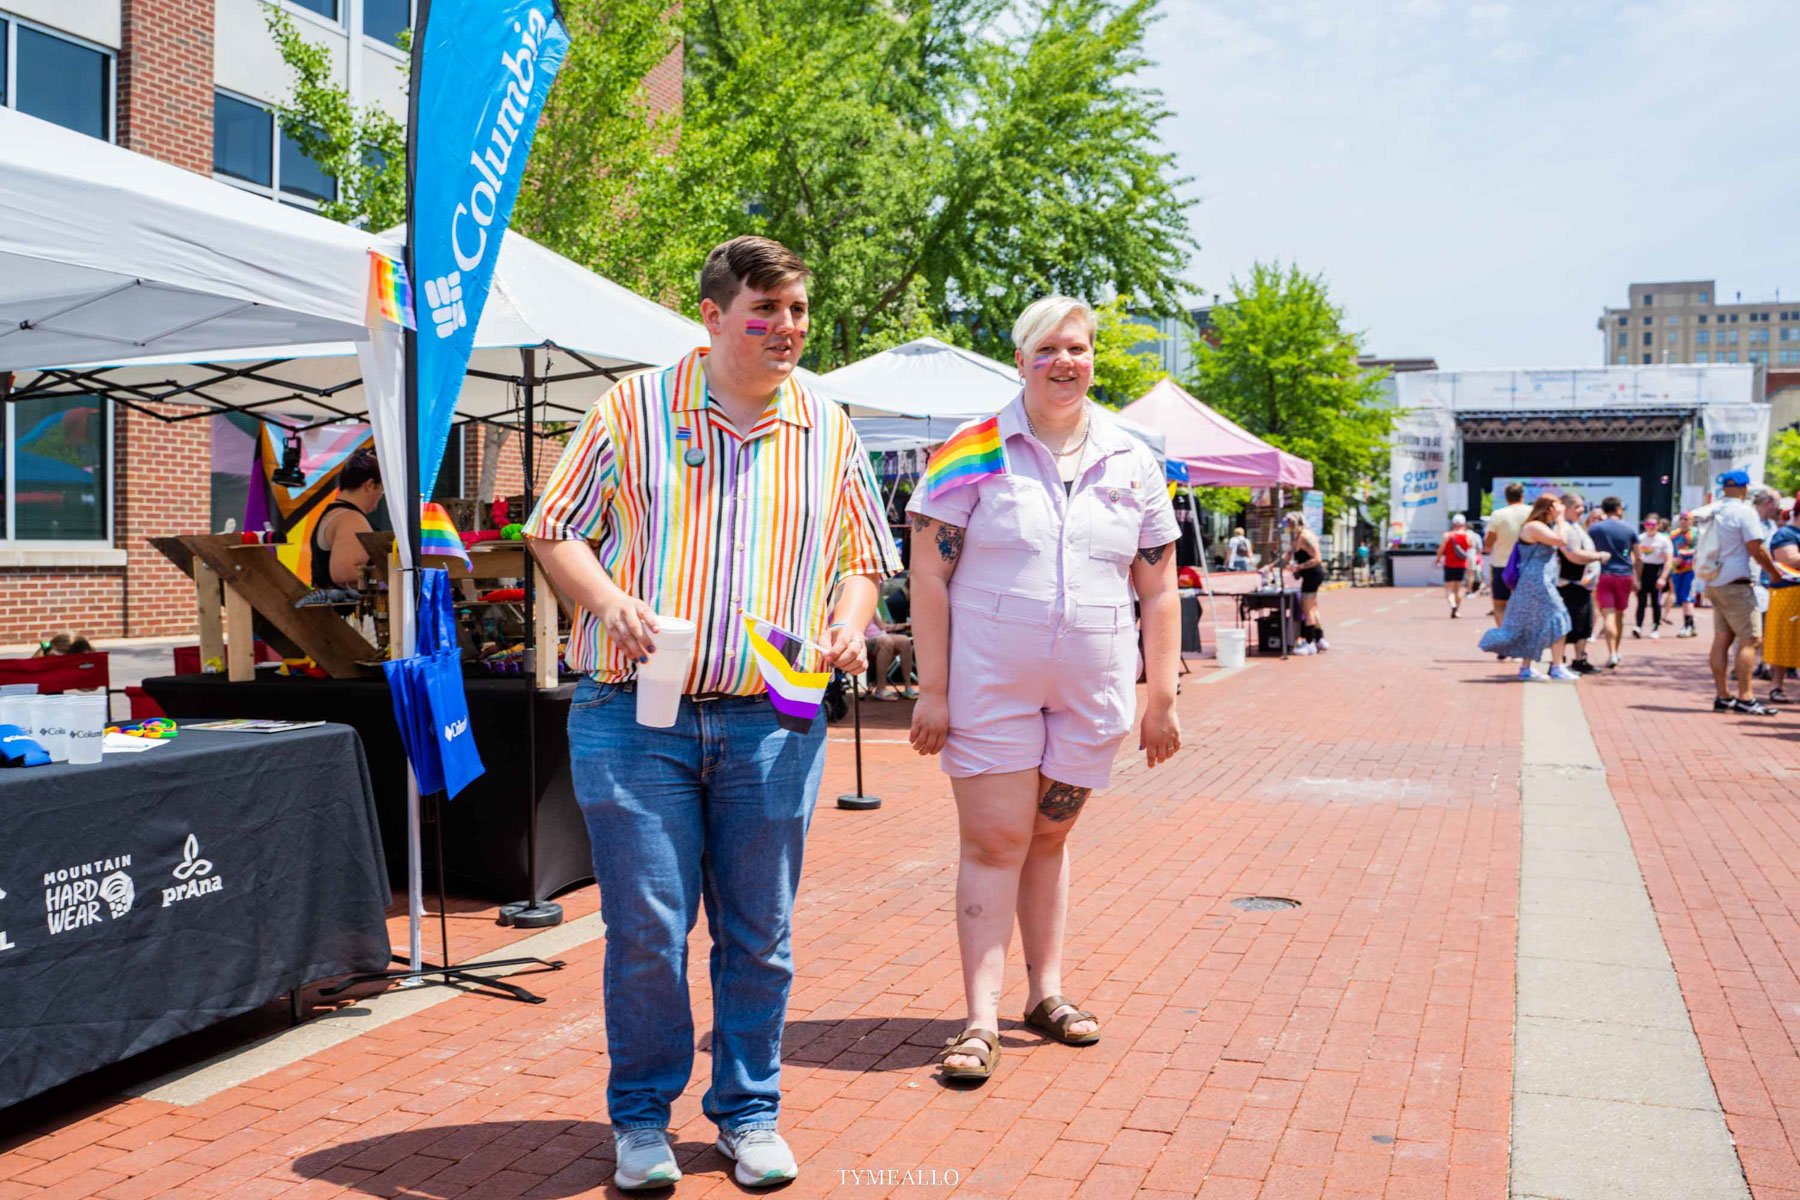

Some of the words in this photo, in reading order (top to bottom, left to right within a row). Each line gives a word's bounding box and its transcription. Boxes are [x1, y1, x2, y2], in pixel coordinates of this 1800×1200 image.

[451, 8, 547, 272] Columbia
[43, 854, 132, 886] MOUNTAIN
[45, 878, 99, 912] HARD
[161, 875, 224, 908] prAna
[47, 901, 104, 936] WEAR
